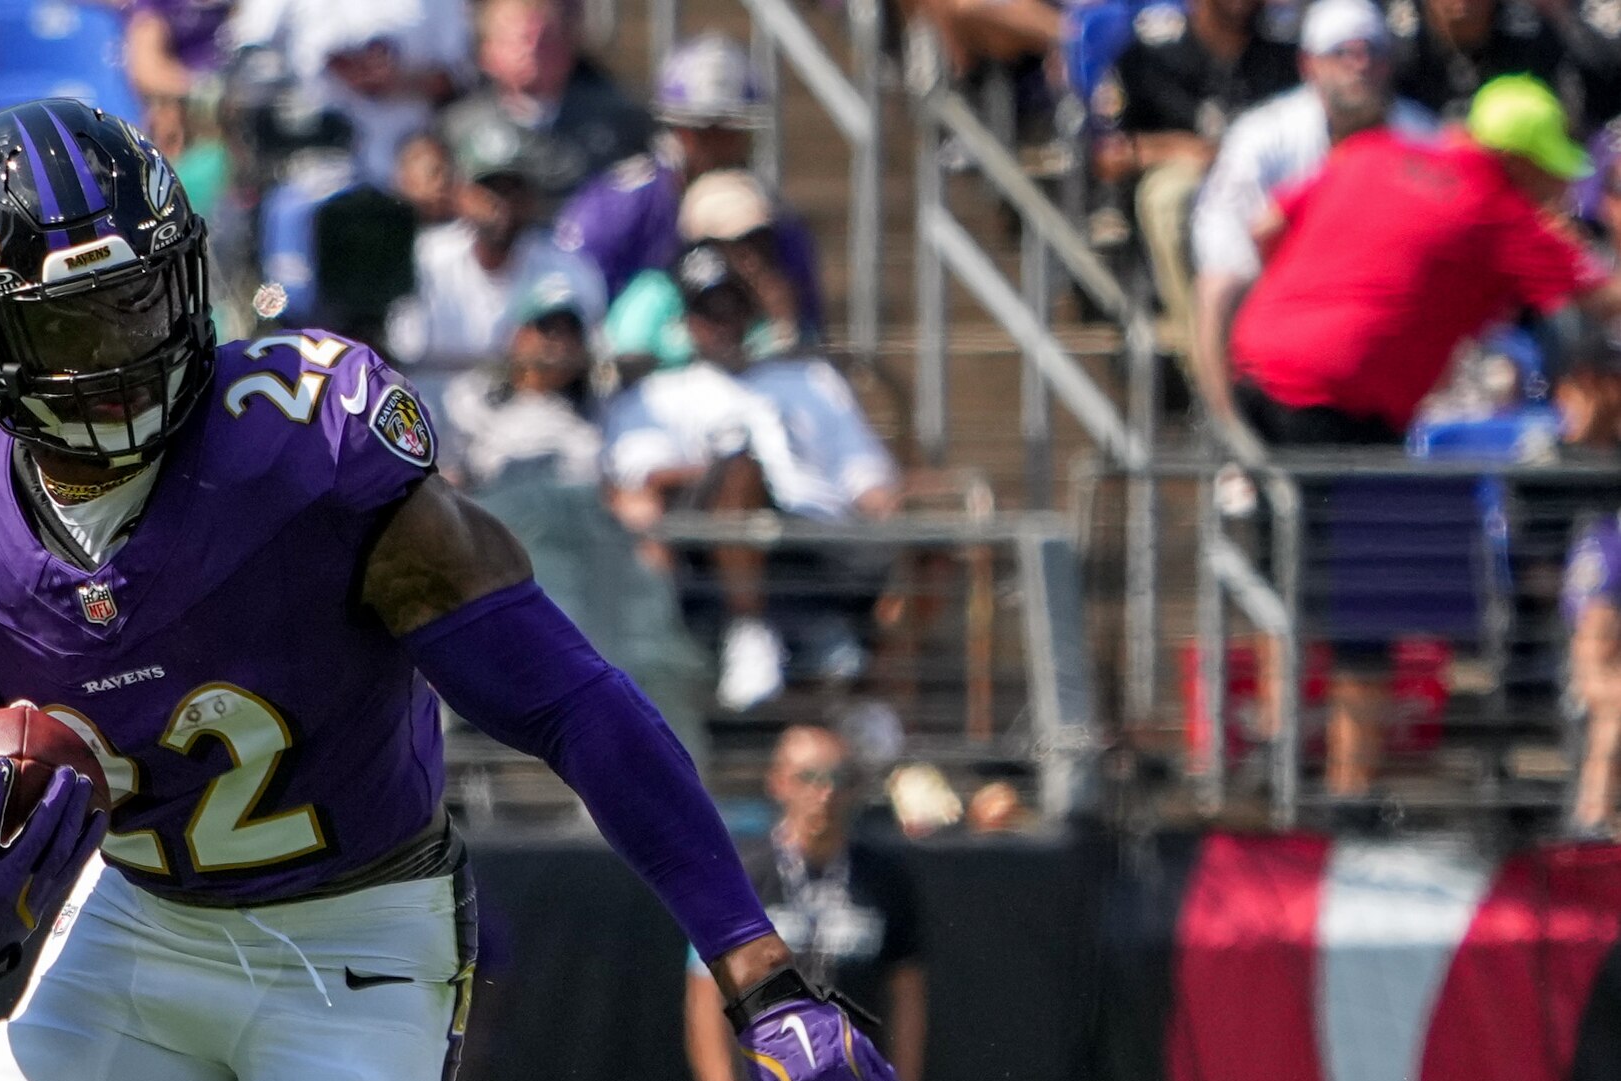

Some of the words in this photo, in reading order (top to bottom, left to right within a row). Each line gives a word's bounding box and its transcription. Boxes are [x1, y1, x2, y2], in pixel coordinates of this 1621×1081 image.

[63, 246, 112, 272] RAVENS
[224, 333, 351, 424] 22
[378, 391, 404, 429] RAVENS
[88, 601, 114, 620] NFL
[81, 667, 166, 694] RAVENS
